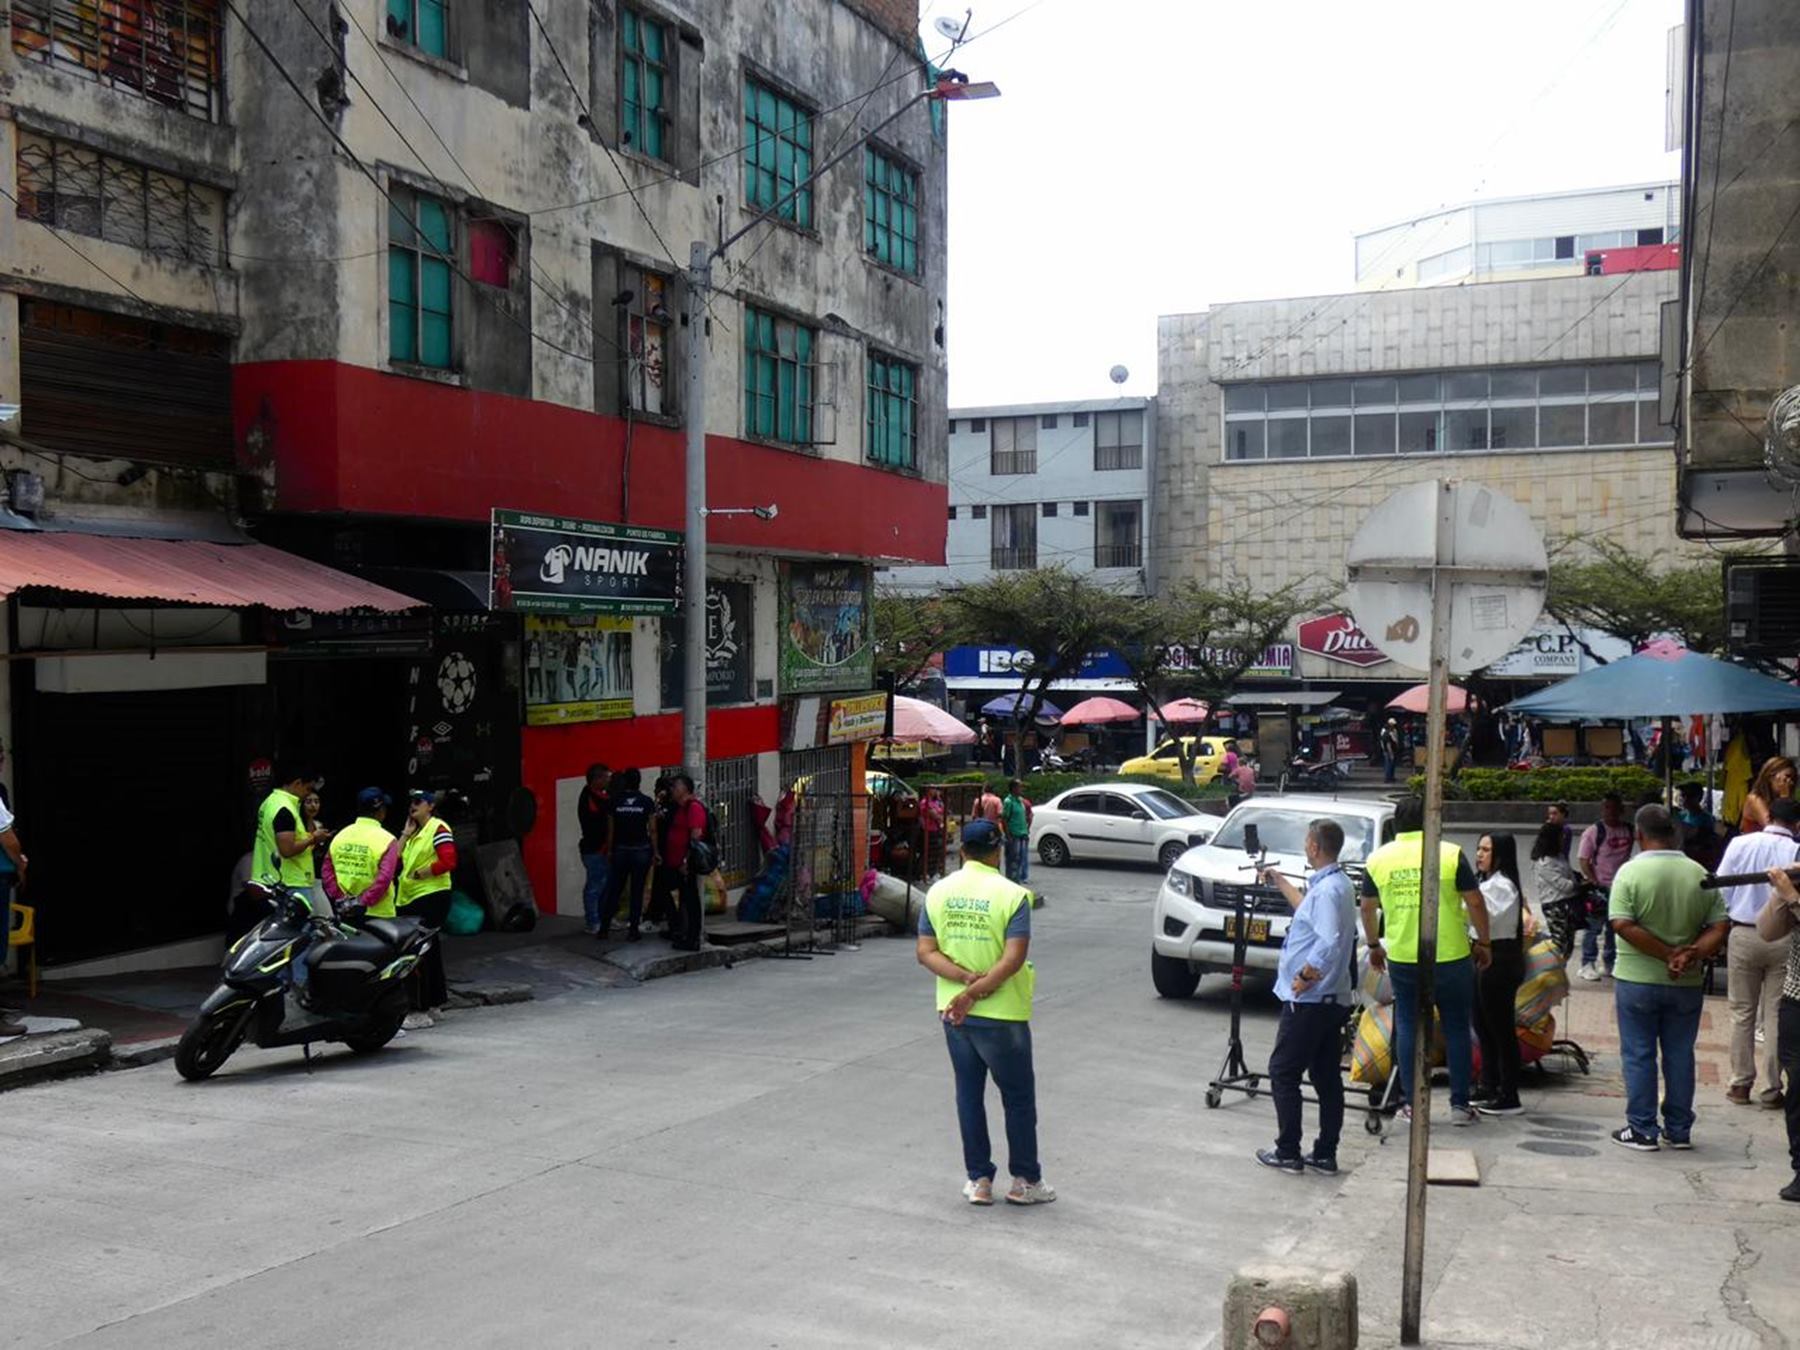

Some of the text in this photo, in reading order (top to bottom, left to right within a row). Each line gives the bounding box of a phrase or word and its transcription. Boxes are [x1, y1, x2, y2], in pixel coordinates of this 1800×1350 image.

[574, 546, 650, 576] NANIK
[584, 574, 640, 589] SPORT
[708, 615, 718, 639] E
[1536, 634, 1573, 654] C.P.
[1534, 654, 1576, 668] COMPANY
